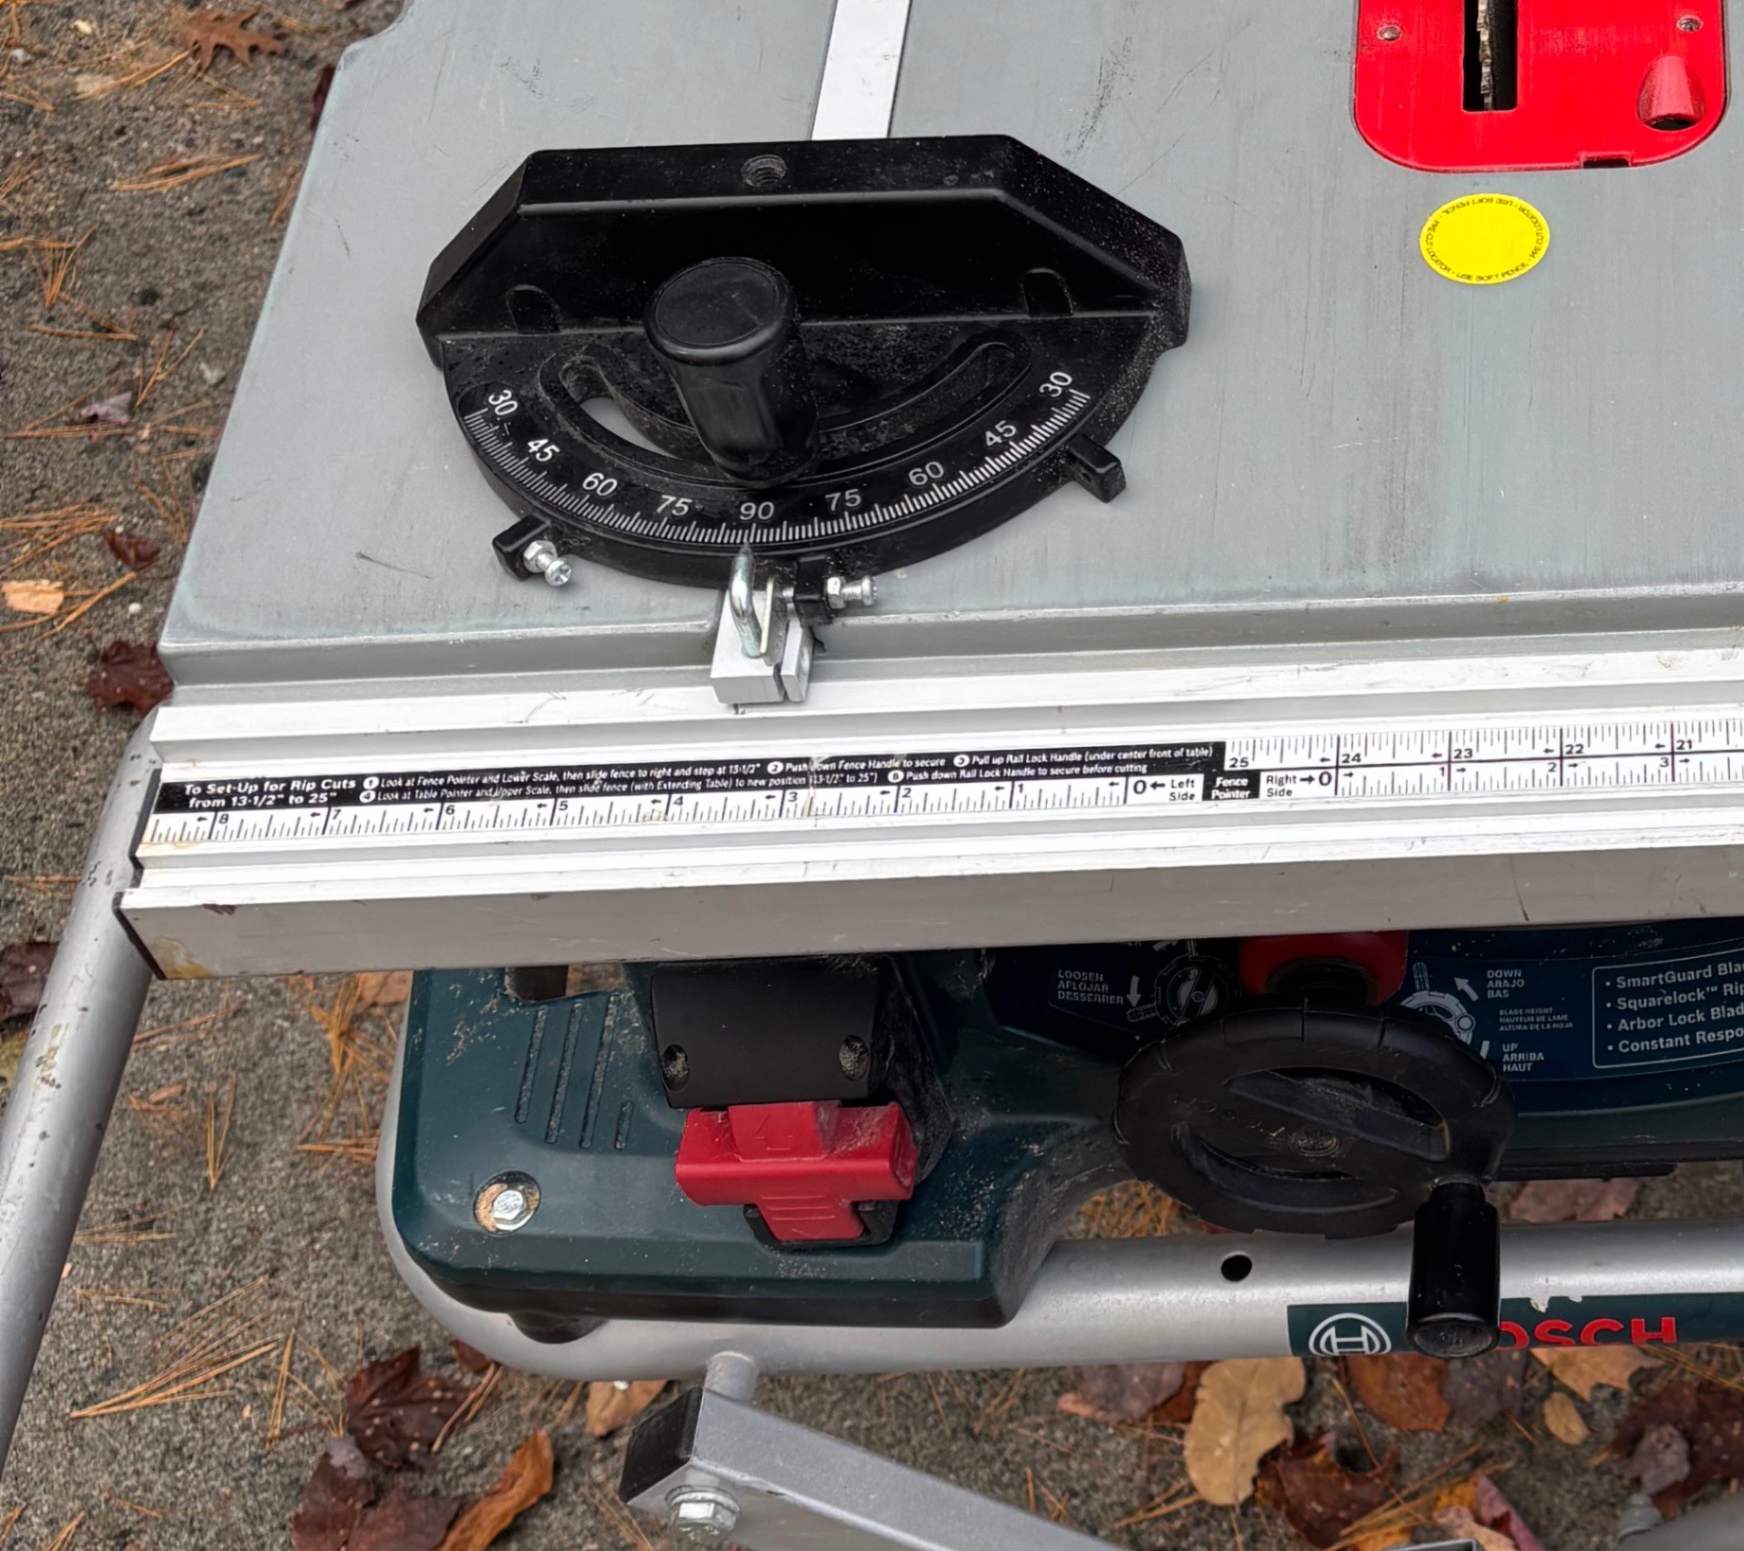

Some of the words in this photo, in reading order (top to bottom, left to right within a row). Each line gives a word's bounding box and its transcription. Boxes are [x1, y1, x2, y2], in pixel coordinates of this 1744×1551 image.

[1039, 371, 1073, 398] 30
[487, 389, 518, 416] 30
[984, 420, 1017, 447] 45
[527, 438, 560, 462] 45
[907, 461, 945, 486] 60
[582, 472, 618, 497] 60
[656, 494, 693, 517] 75
[824, 488, 861, 511] 75
[739, 501, 775, 521] 90
[1026, 752, 1047, 763] Lock
[1050, 750, 1082, 762] Handle
[1229, 757, 1249, 769] 25
[1341, 753, 1361, 764] 24
[1454, 748, 1473, 760] 23
[1565, 744, 1584, 755] 22
[1676, 738, 1693, 750] 21
[838, 759, 866, 770] Fence
[914, 757, 946, 768] secure
[905, 770, 929, 782] Push
[931, 769, 956, 781] down
[958, 768, 976, 779] Rail
[980, 767, 1001, 778] Lock
[1004, 766, 1035, 778] Handle
[1050, 764, 1080, 776] secure
[1082, 763, 1113, 775] before
[1115, 762, 1148, 774] cutting
[1548, 762, 1557, 773] 2
[1659, 757, 1669, 768] 3
[417, 775, 444, 786] Fence
[562, 770, 584, 781] then
[610, 768, 636, 780] fence
[650, 766, 672, 779] right
[673, 766, 692, 777] and
[693, 766, 714, 778] stop
[1171, 778, 1195, 789] Left
[1215, 776, 1249, 789] Fence
[1266, 774, 1297, 788] Right
[1319, 771, 1333, 786] 0
[185, 783, 201, 796] To
[206, 782, 259, 797] Set-Up
[263, 780, 285, 792] for
[290, 779, 316, 793] Rip
[320, 778, 356, 791] Cuts
[556, 784, 577, 795] then
[705, 777, 733, 790] Table)
[746, 777, 767, 788] new
[1266, 787, 1294, 798] Side
[189, 796, 226, 808] from
[288, 794, 304, 806] to
[308, 792, 338, 804] 25"
[218, 813, 230, 825] 8
[332, 809, 342, 820] 7
[445, 804, 456, 816] 6
[558, 800, 569, 811] 5
[673, 795, 684, 806] 4
[788, 791, 798, 802] 3
[901, 788, 912, 798] 2
[1133, 780, 1147, 795] 0
[1169, 791, 1196, 801] Side
[1211, 789, 1251, 801] Pointer
[1057, 969, 1104, 982] LOOSEN
[1486, 968, 1523, 980] DOWN
[1616, 965, 1713, 990] SmartGuard
[1057, 980, 1109, 994] AFLOJAR
[1486, 978, 1525, 990] ABAJO
[1057, 990, 1124, 1006] DESSERRER
[1487, 989, 1510, 1001] BAS
[1617, 1017, 1664, 1032] Arbor
[1668, 1009, 1706, 1027] Lock
[1502, 1042, 1519, 1053] UP
[1618, 1034, 1691, 1053] Constant
[1502, 1051, 1545, 1064] ARRIBA
[1502, 1061, 1534, 1073] HAUT
[1500, 1317, 1678, 1350] OSCH
